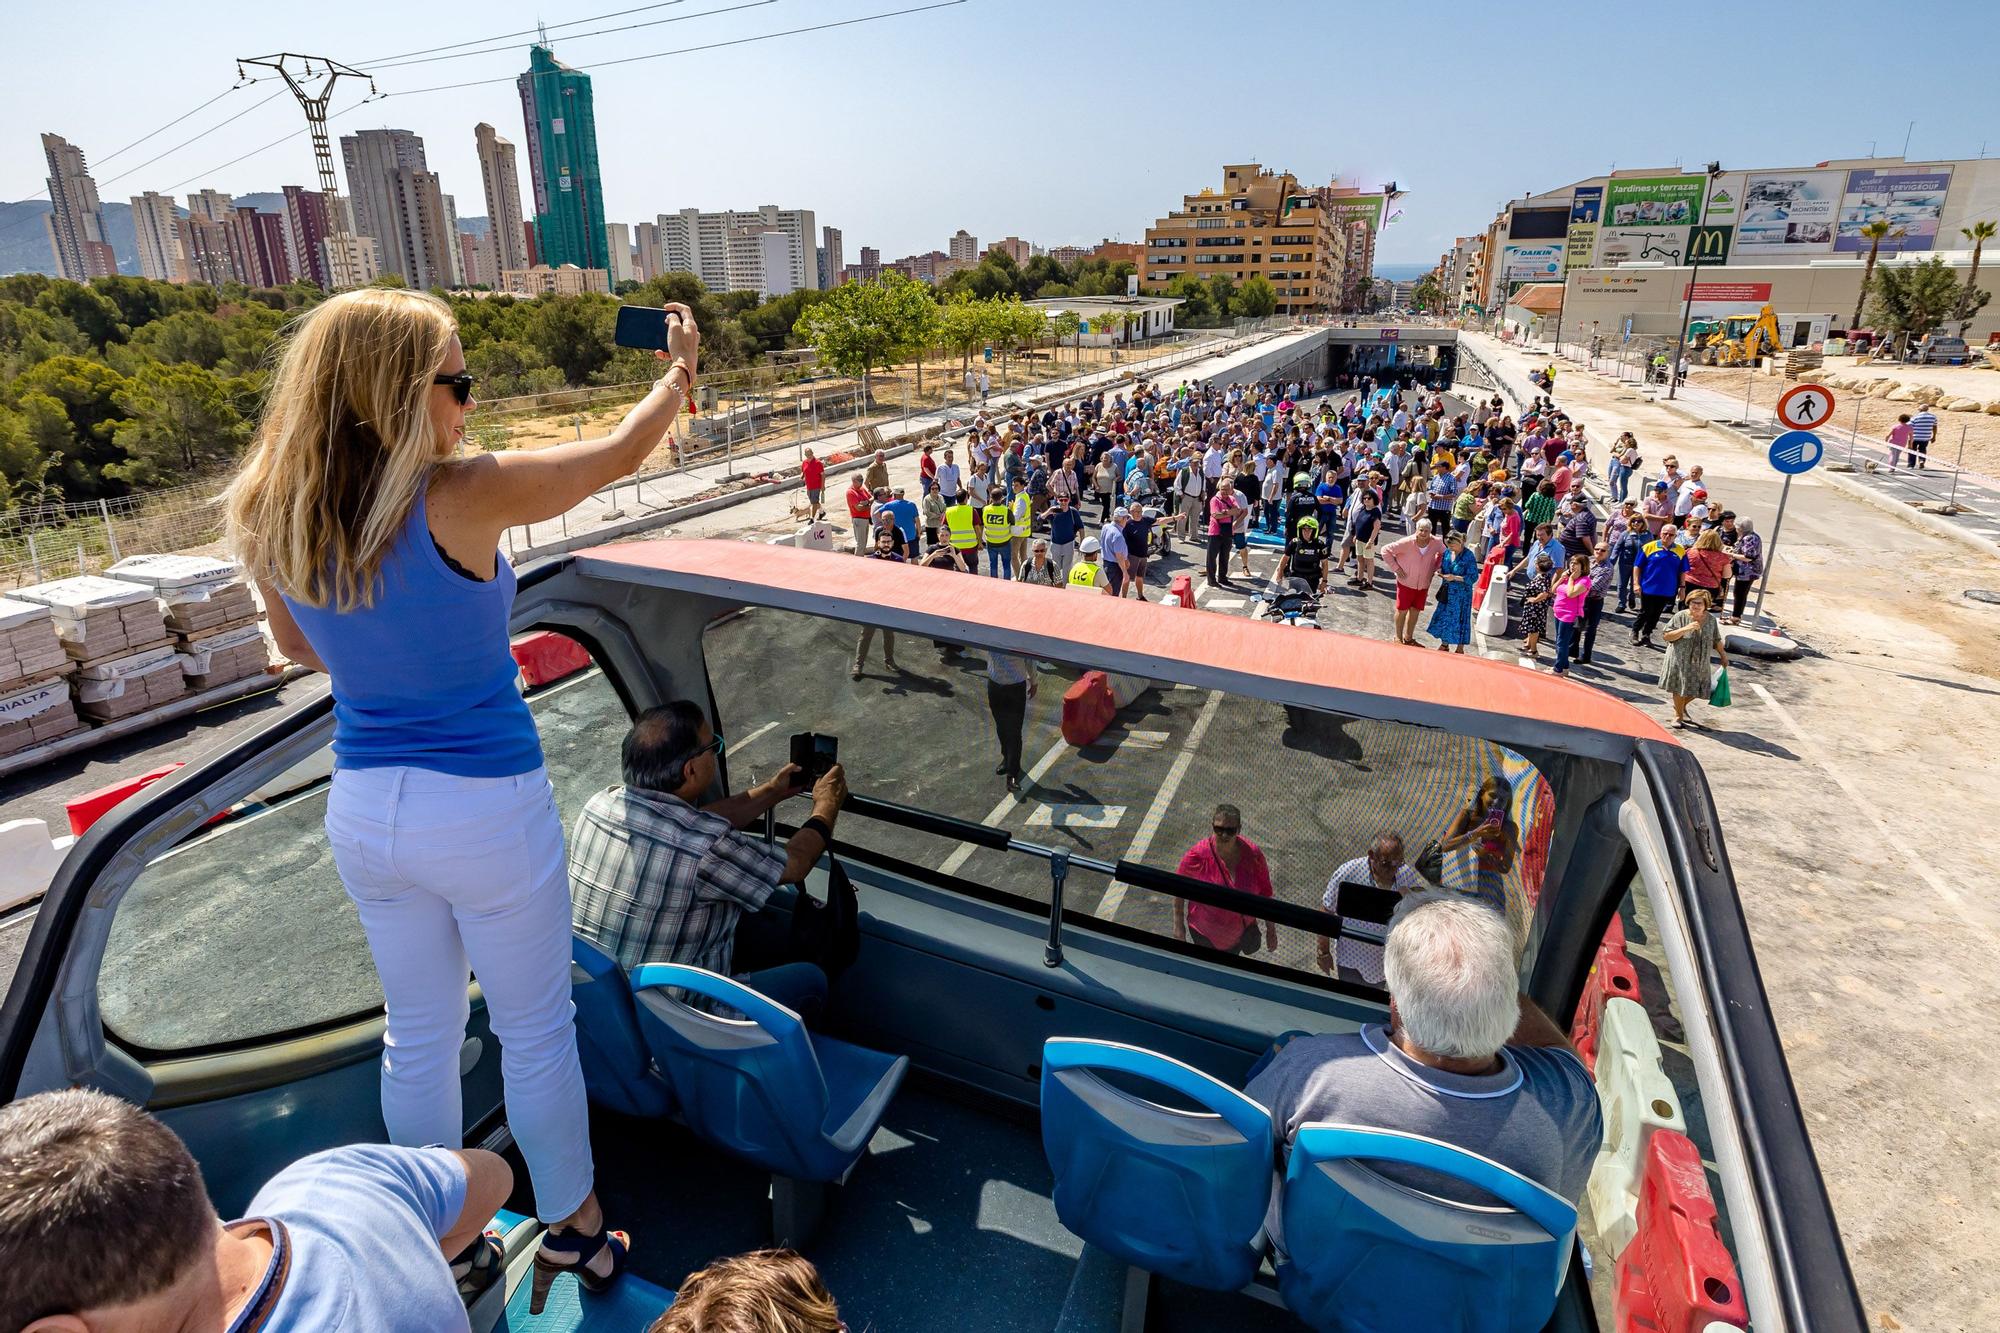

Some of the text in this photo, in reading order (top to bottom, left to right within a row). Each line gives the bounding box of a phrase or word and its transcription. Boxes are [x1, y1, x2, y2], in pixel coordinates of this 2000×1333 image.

[1613, 184, 1651, 193] Jardines
[1660, 183, 1699, 191] terrazas
[1890, 183, 1939, 191] SERVIGROUP
[1338, 204, 1376, 212] terrazas
